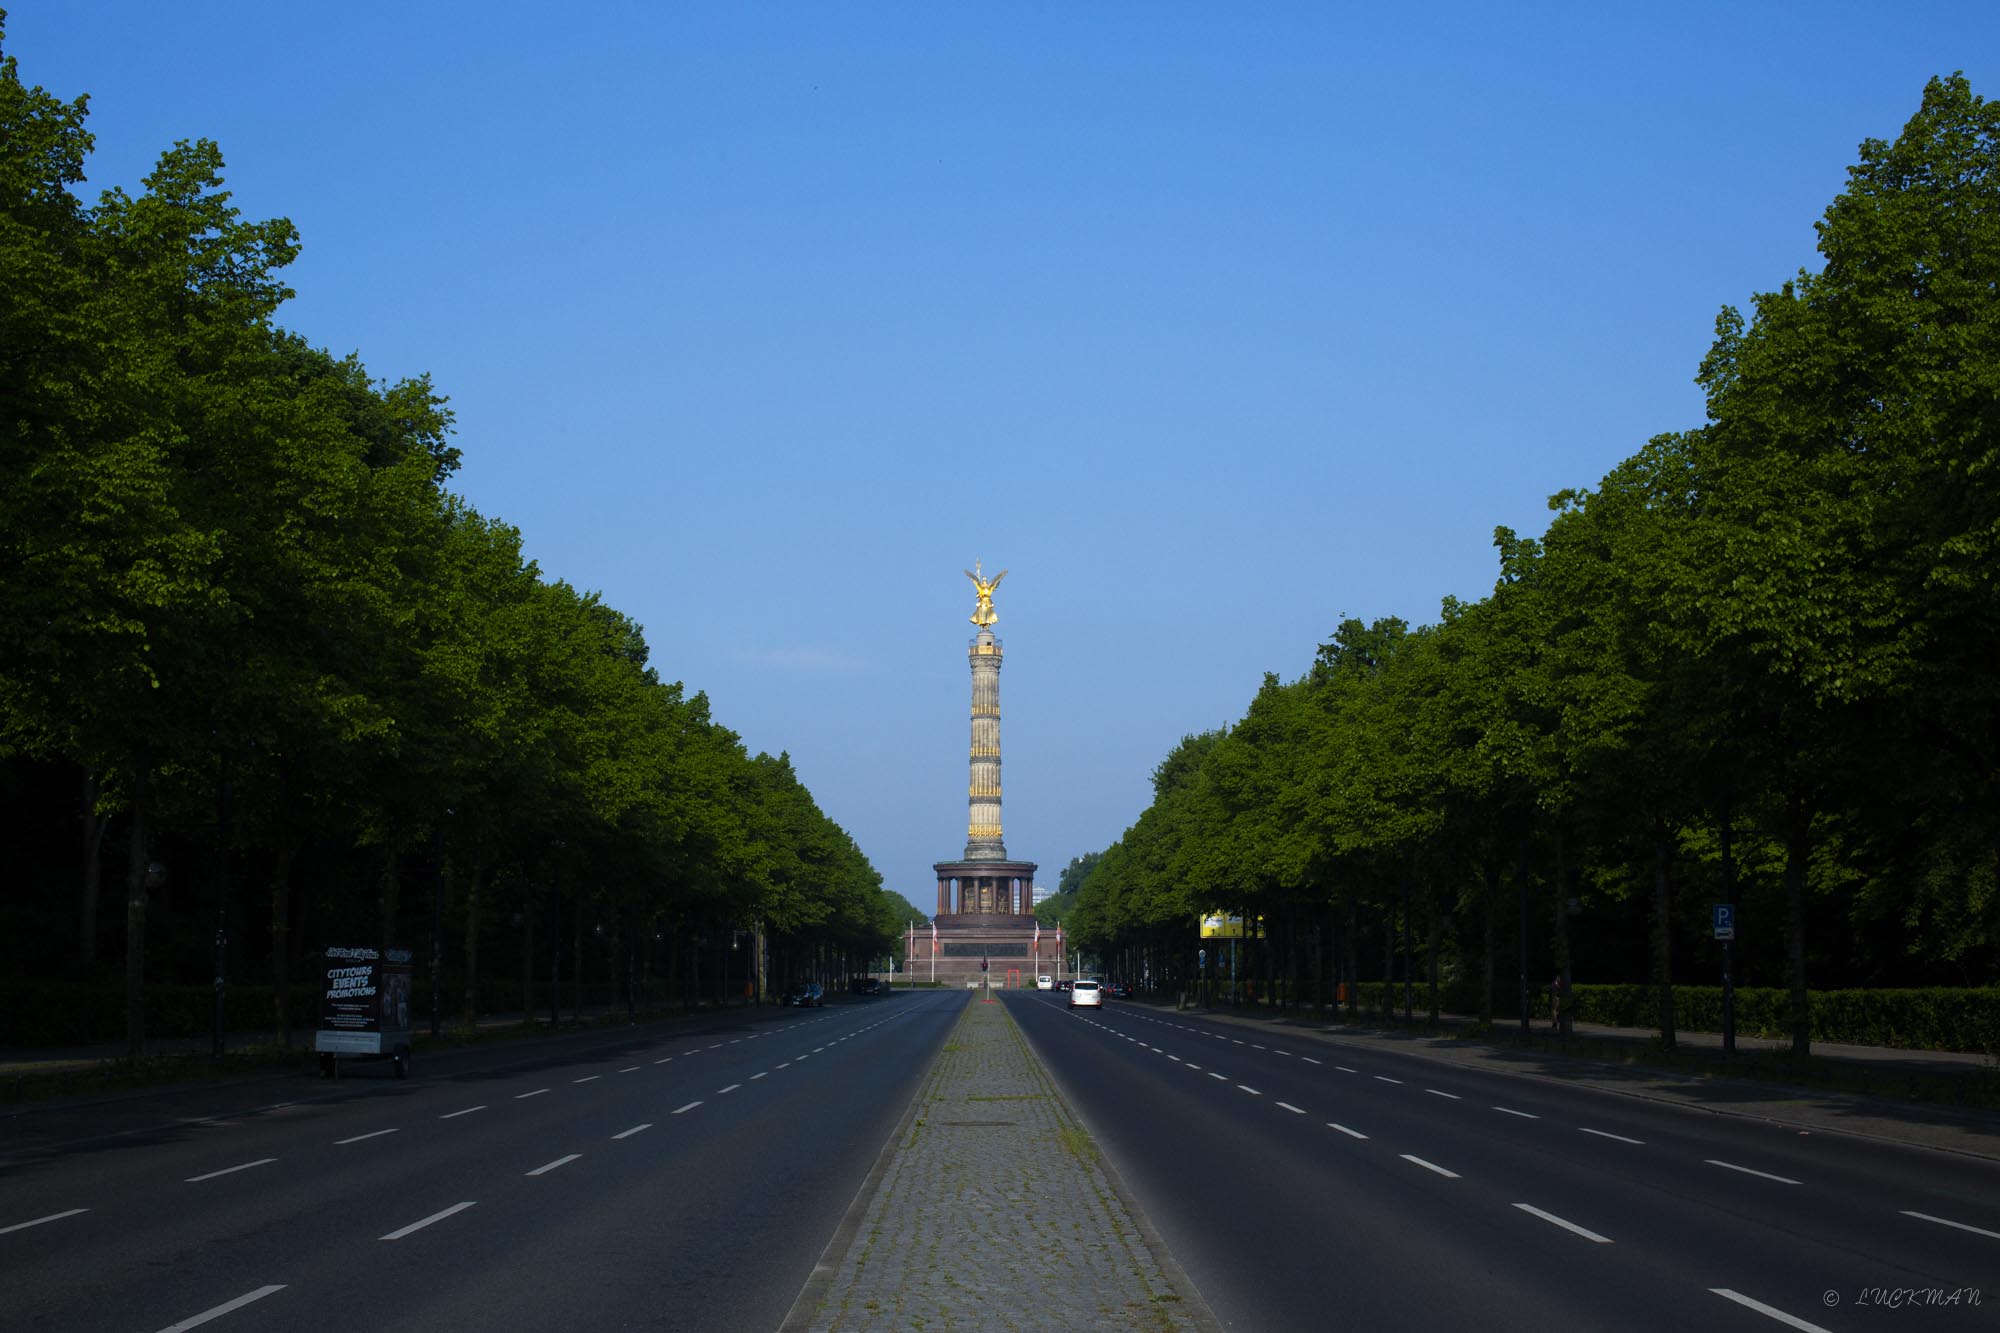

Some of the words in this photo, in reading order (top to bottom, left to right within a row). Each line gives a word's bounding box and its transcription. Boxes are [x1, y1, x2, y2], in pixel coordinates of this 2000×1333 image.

[1718, 907, 1729, 925] P
[327, 966, 372, 979] CITYTOURS
[332, 976, 369, 989] EVENTS
[326, 986, 376, 999] PROMOTIONS
